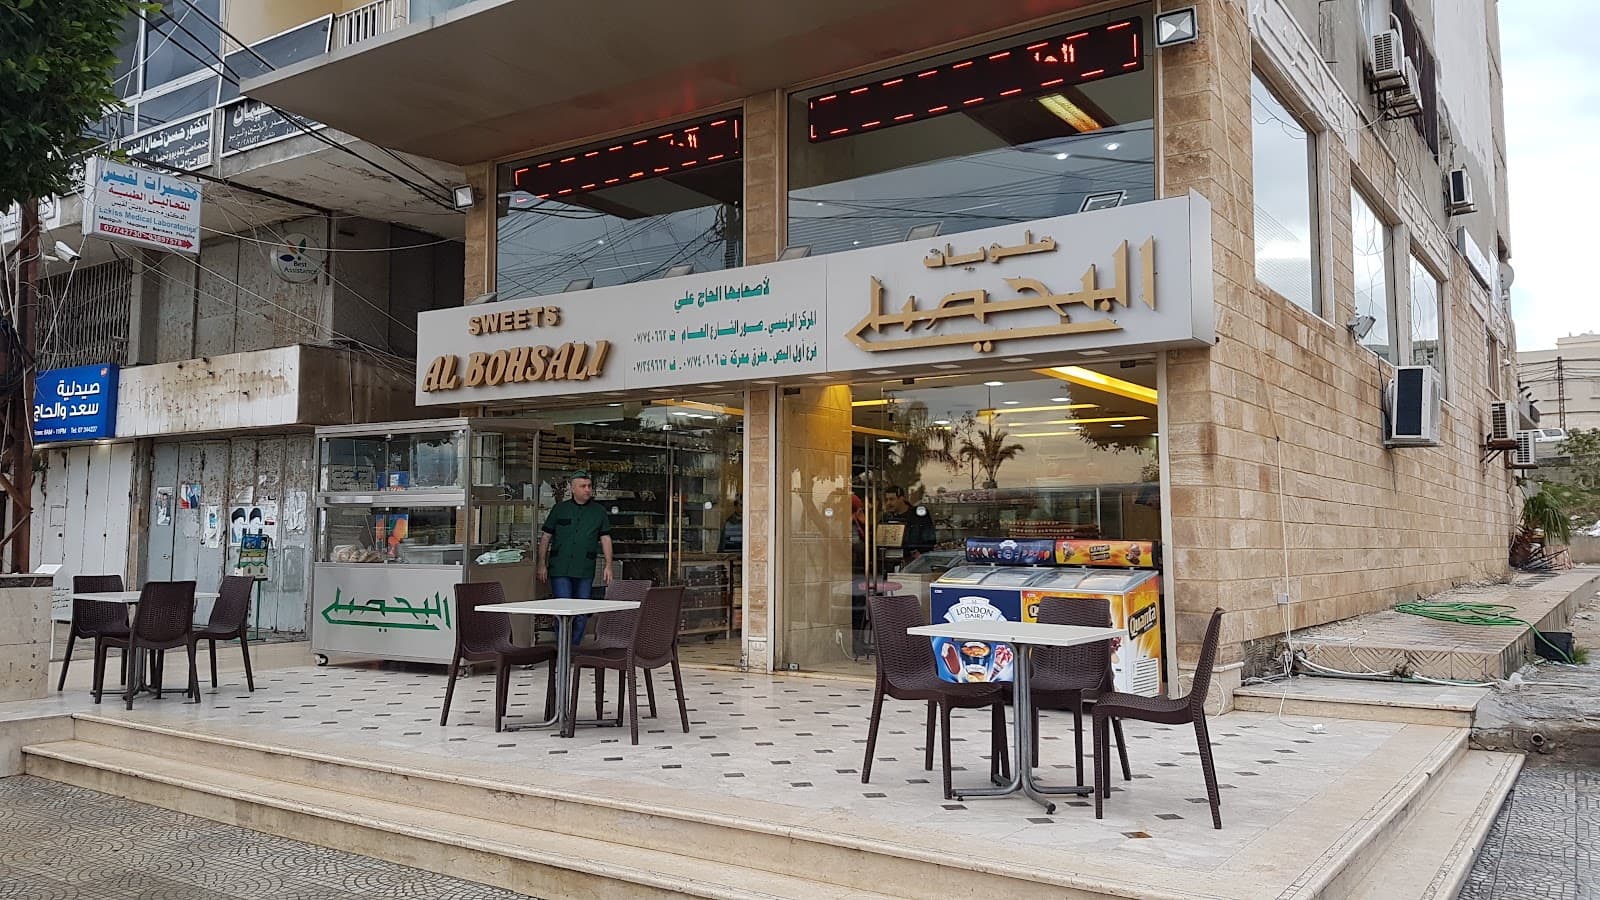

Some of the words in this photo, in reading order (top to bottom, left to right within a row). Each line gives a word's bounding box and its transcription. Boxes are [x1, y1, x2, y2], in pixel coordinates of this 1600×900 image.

[109, 183, 146, 201] الطبية
[144, 176, 198, 200] مختبرات
[149, 195, 191, 211] للتحاليل
[125, 211, 152, 224] Medical
[923, 229, 1058, 272] حلويات
[293, 260, 307, 268] Best
[674, 290, 694, 313] علي
[698, 285, 722, 308] الحاج
[844, 234, 1158, 353] البحصلي
[468, 305, 561, 336] SWEETS
[710, 319, 738, 340] الشارع
[740, 320, 763, 337] صور
[798, 310, 816, 330] المركز
[682, 323, 709, 344] العام
[807, 341, 817, 361] فرع
[421, 353, 460, 393] AL
[464, 339, 611, 388] BOHSALI
[57, 379, 100, 401] صيدلية
[34, 402, 67, 422] والحاج
[69, 402, 99, 417] سعد
[956, 605, 994, 617] LONDON
[1130, 606, 1157, 637] Quanta
